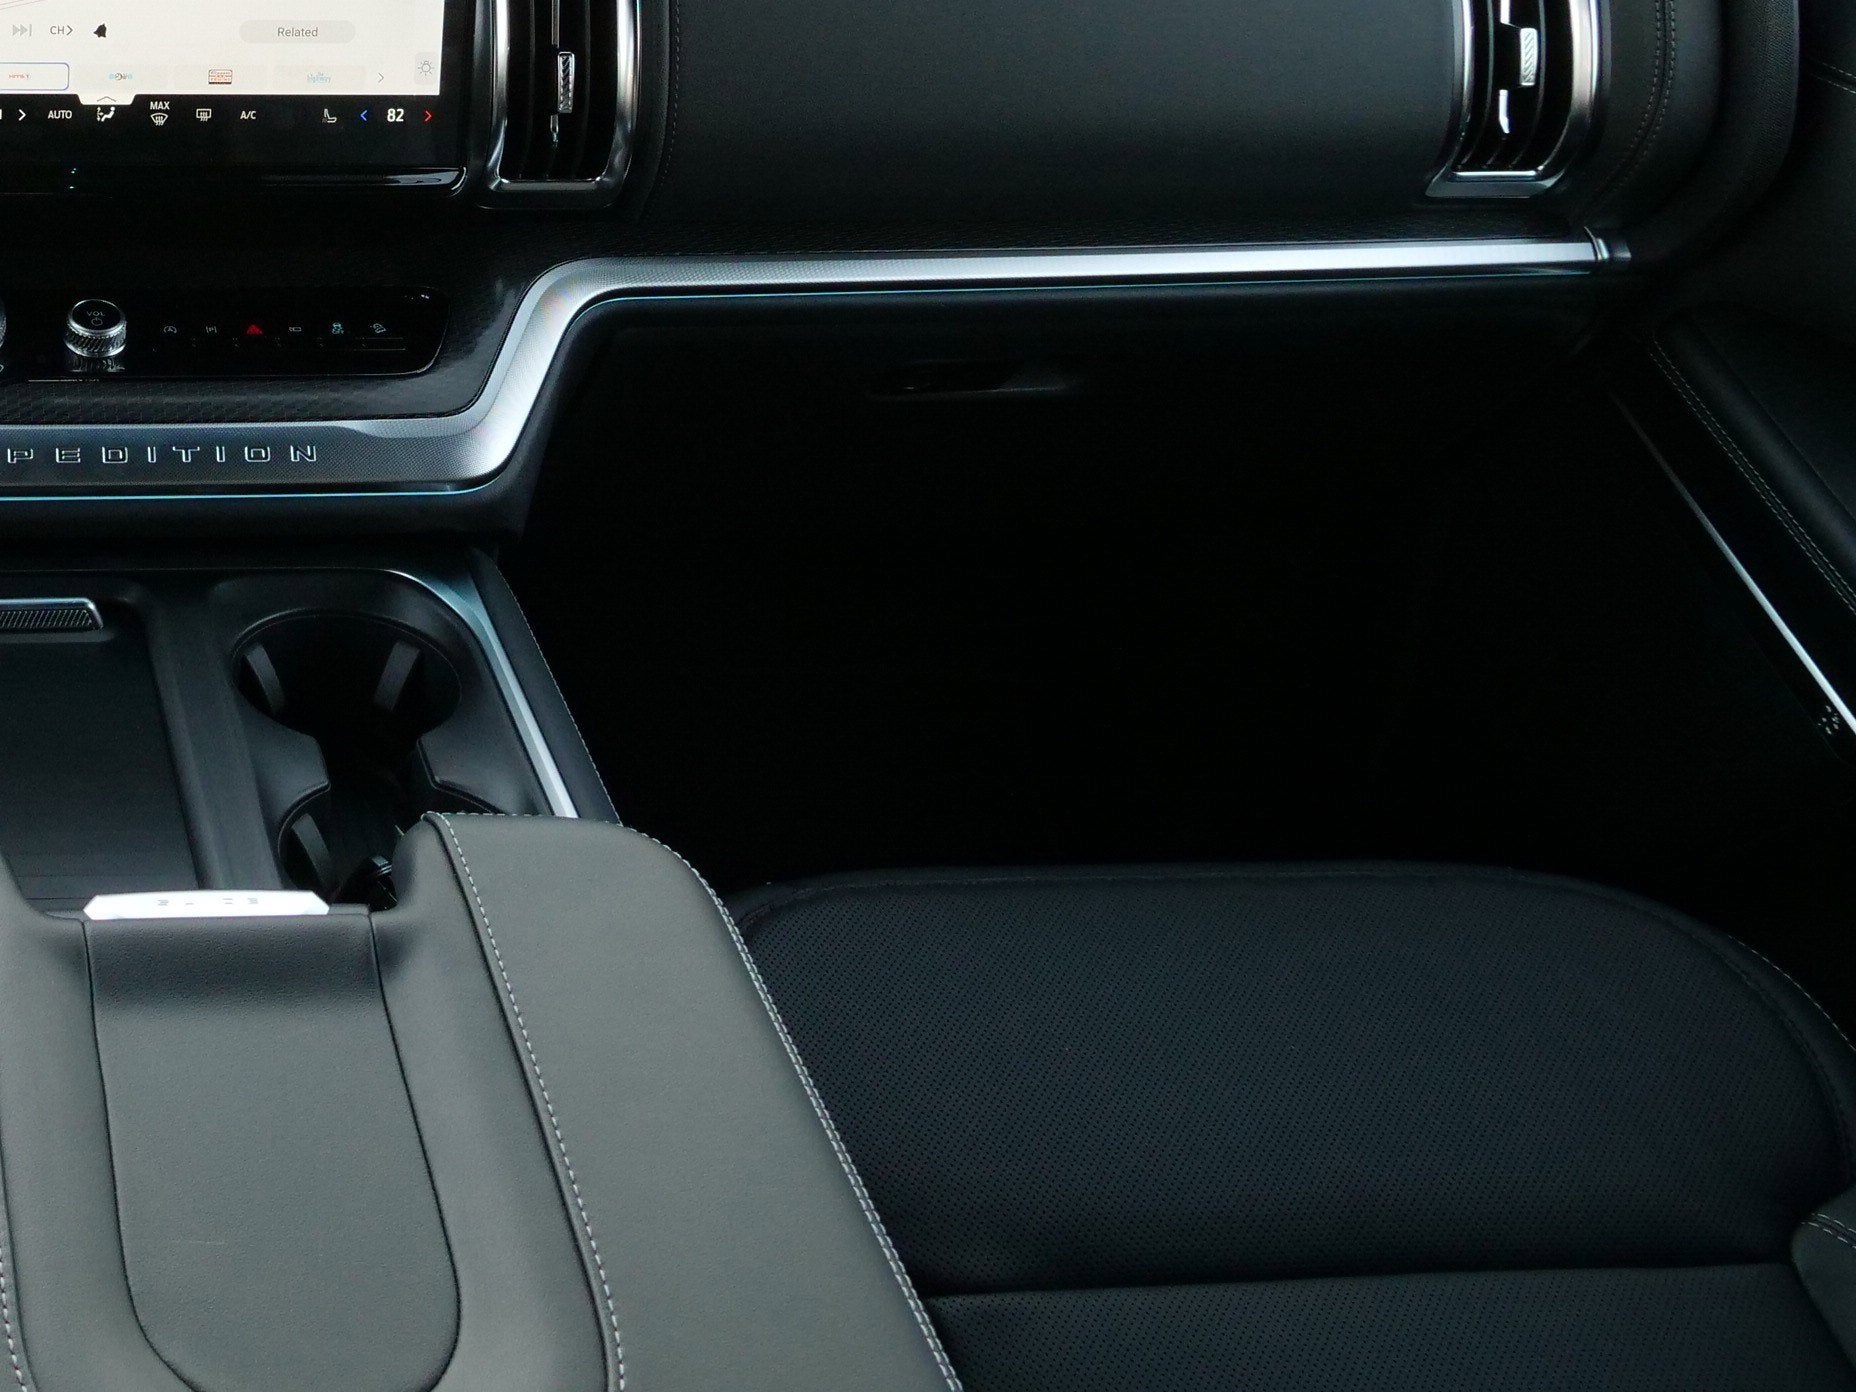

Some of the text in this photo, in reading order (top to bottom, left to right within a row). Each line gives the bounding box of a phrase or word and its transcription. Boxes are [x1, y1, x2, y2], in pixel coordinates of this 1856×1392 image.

[50, 25, 65, 35] CH
[277, 26, 319, 38] Related
[150, 101, 170, 110] MAX
[47, 110, 73, 120] AUTO
[240, 110, 257, 121] A/C
[387, 109, 404, 122] 82
